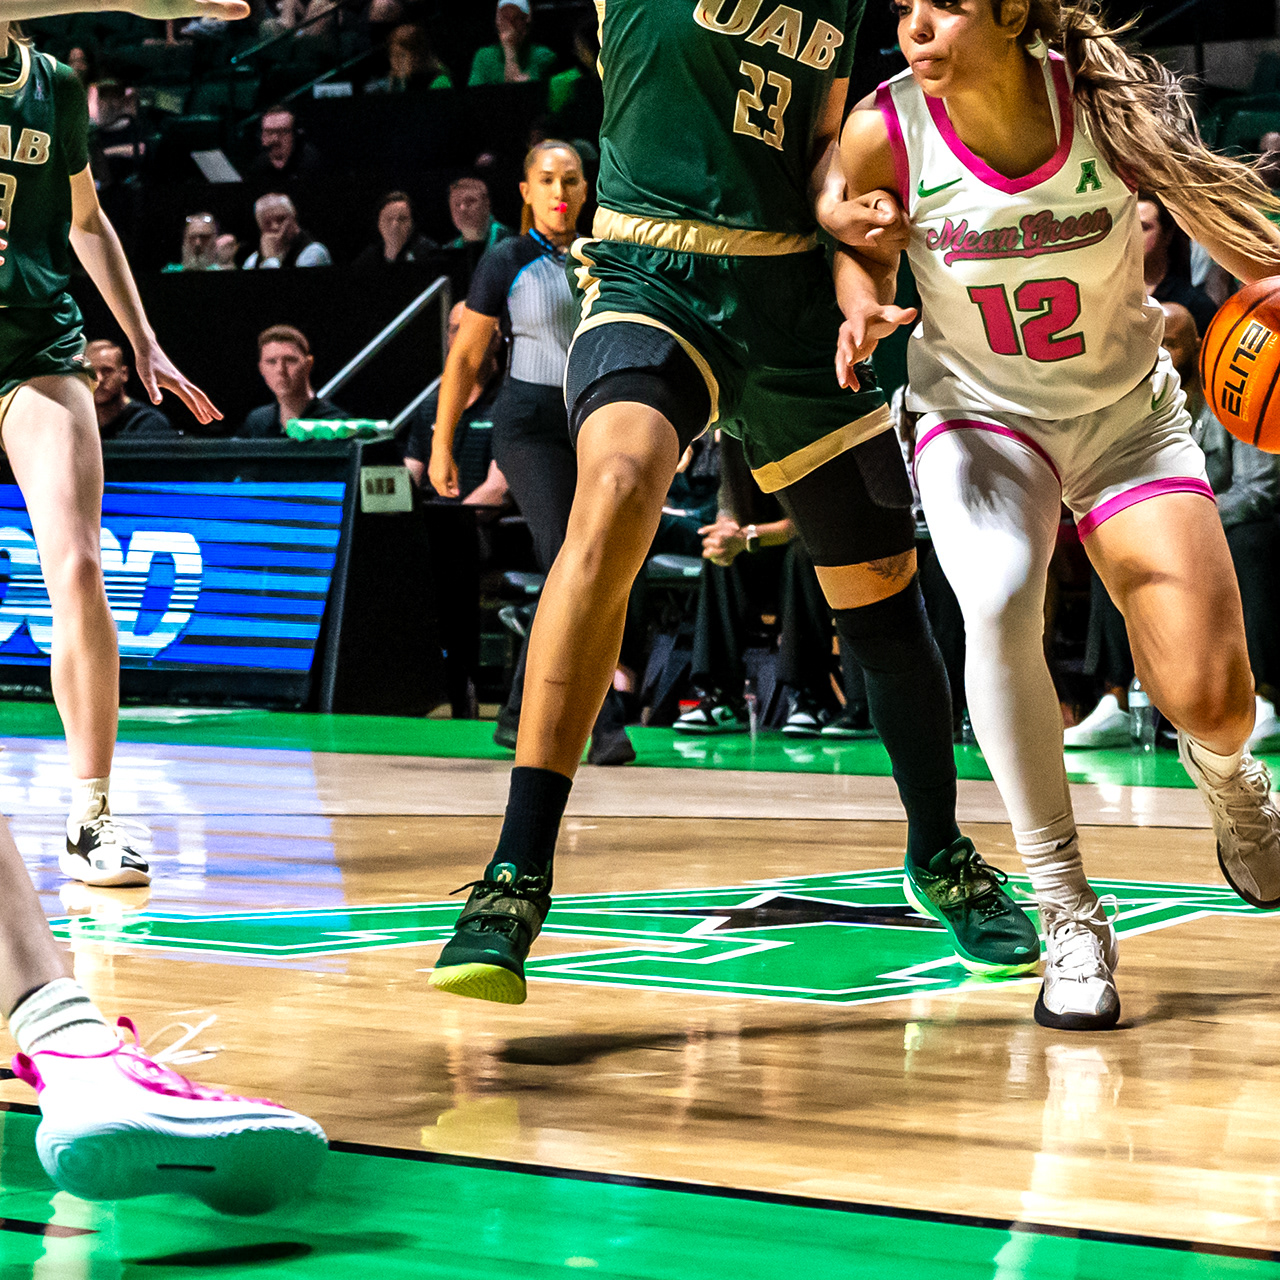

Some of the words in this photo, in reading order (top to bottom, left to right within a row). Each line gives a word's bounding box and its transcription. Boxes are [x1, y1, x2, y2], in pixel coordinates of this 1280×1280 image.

[732, 60, 793, 152] 23
[926, 217, 1022, 252] Mean
[1019, 207, 1112, 249] Green
[966, 276, 1086, 362] 12
[1221, 320, 1273, 418] ELITE
